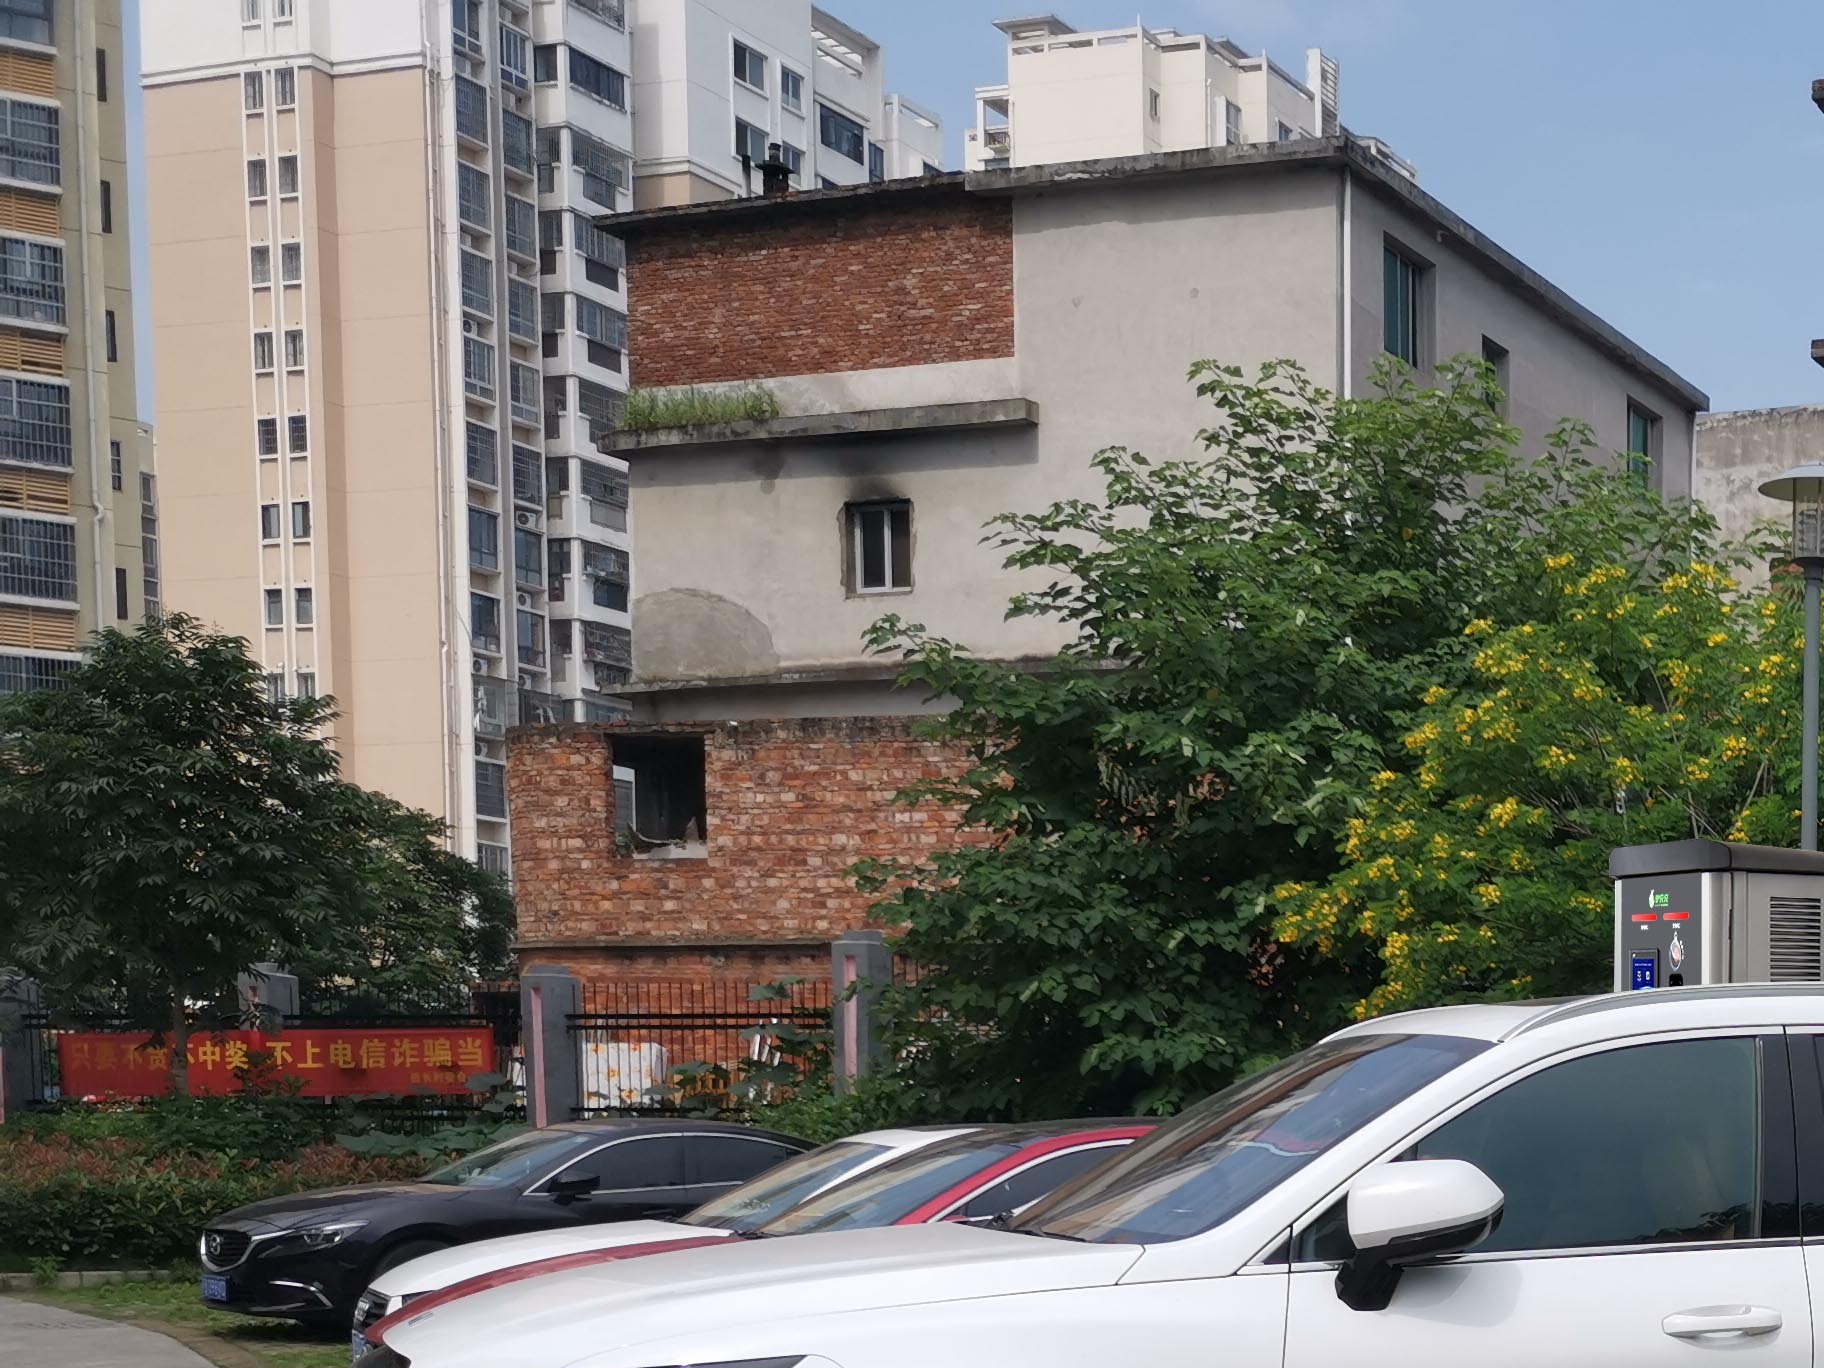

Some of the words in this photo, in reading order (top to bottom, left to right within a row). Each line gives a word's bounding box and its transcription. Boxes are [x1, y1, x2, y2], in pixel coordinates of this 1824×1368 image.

[266, 1037, 483, 1069] 不上电信诈骗当
